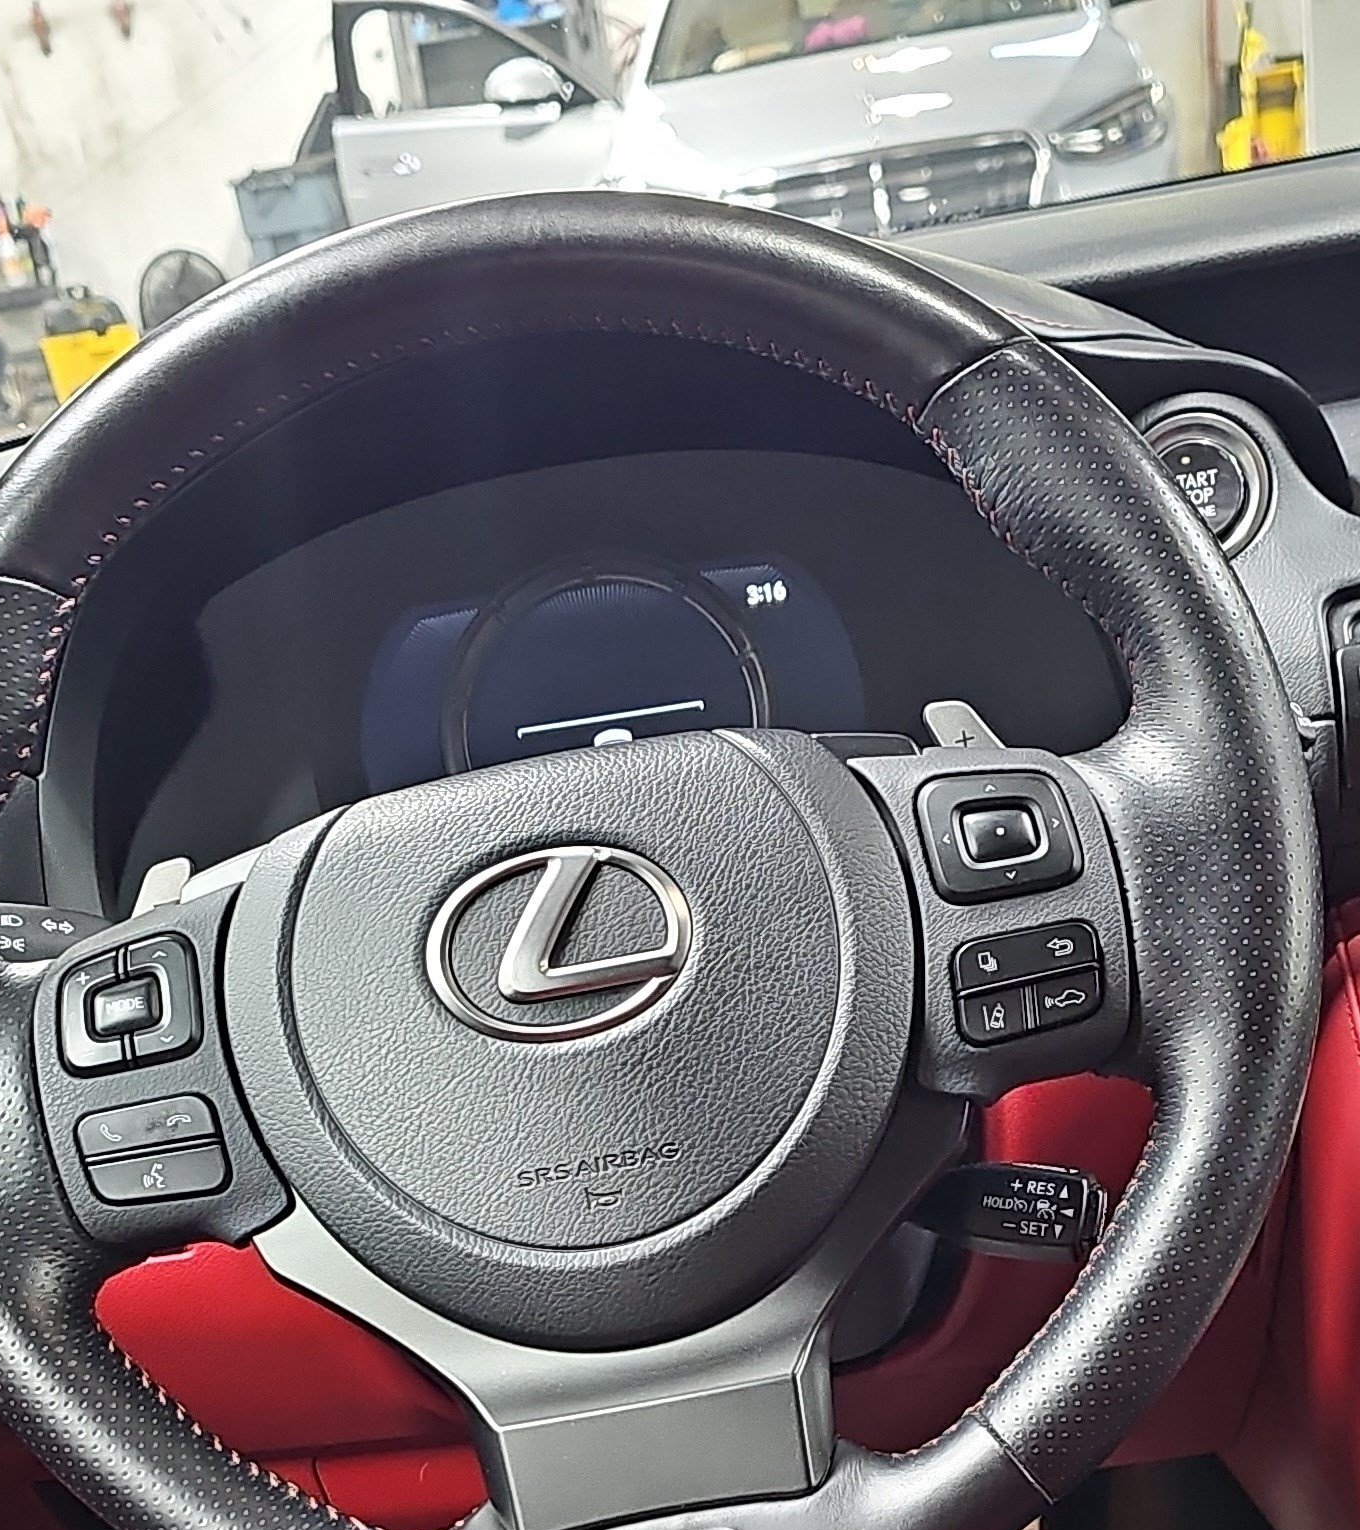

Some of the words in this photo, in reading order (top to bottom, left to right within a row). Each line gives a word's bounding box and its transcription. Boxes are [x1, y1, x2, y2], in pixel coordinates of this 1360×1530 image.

[1175, 468, 1219, 490] TART
[745, 580, 788, 607] 3:16
[105, 996, 146, 1014] MODE
[517, 1164, 573, 1188] SRS
[574, 1140, 682, 1178] AIRBAG
[982, 1195, 1014, 1210] HOLD
